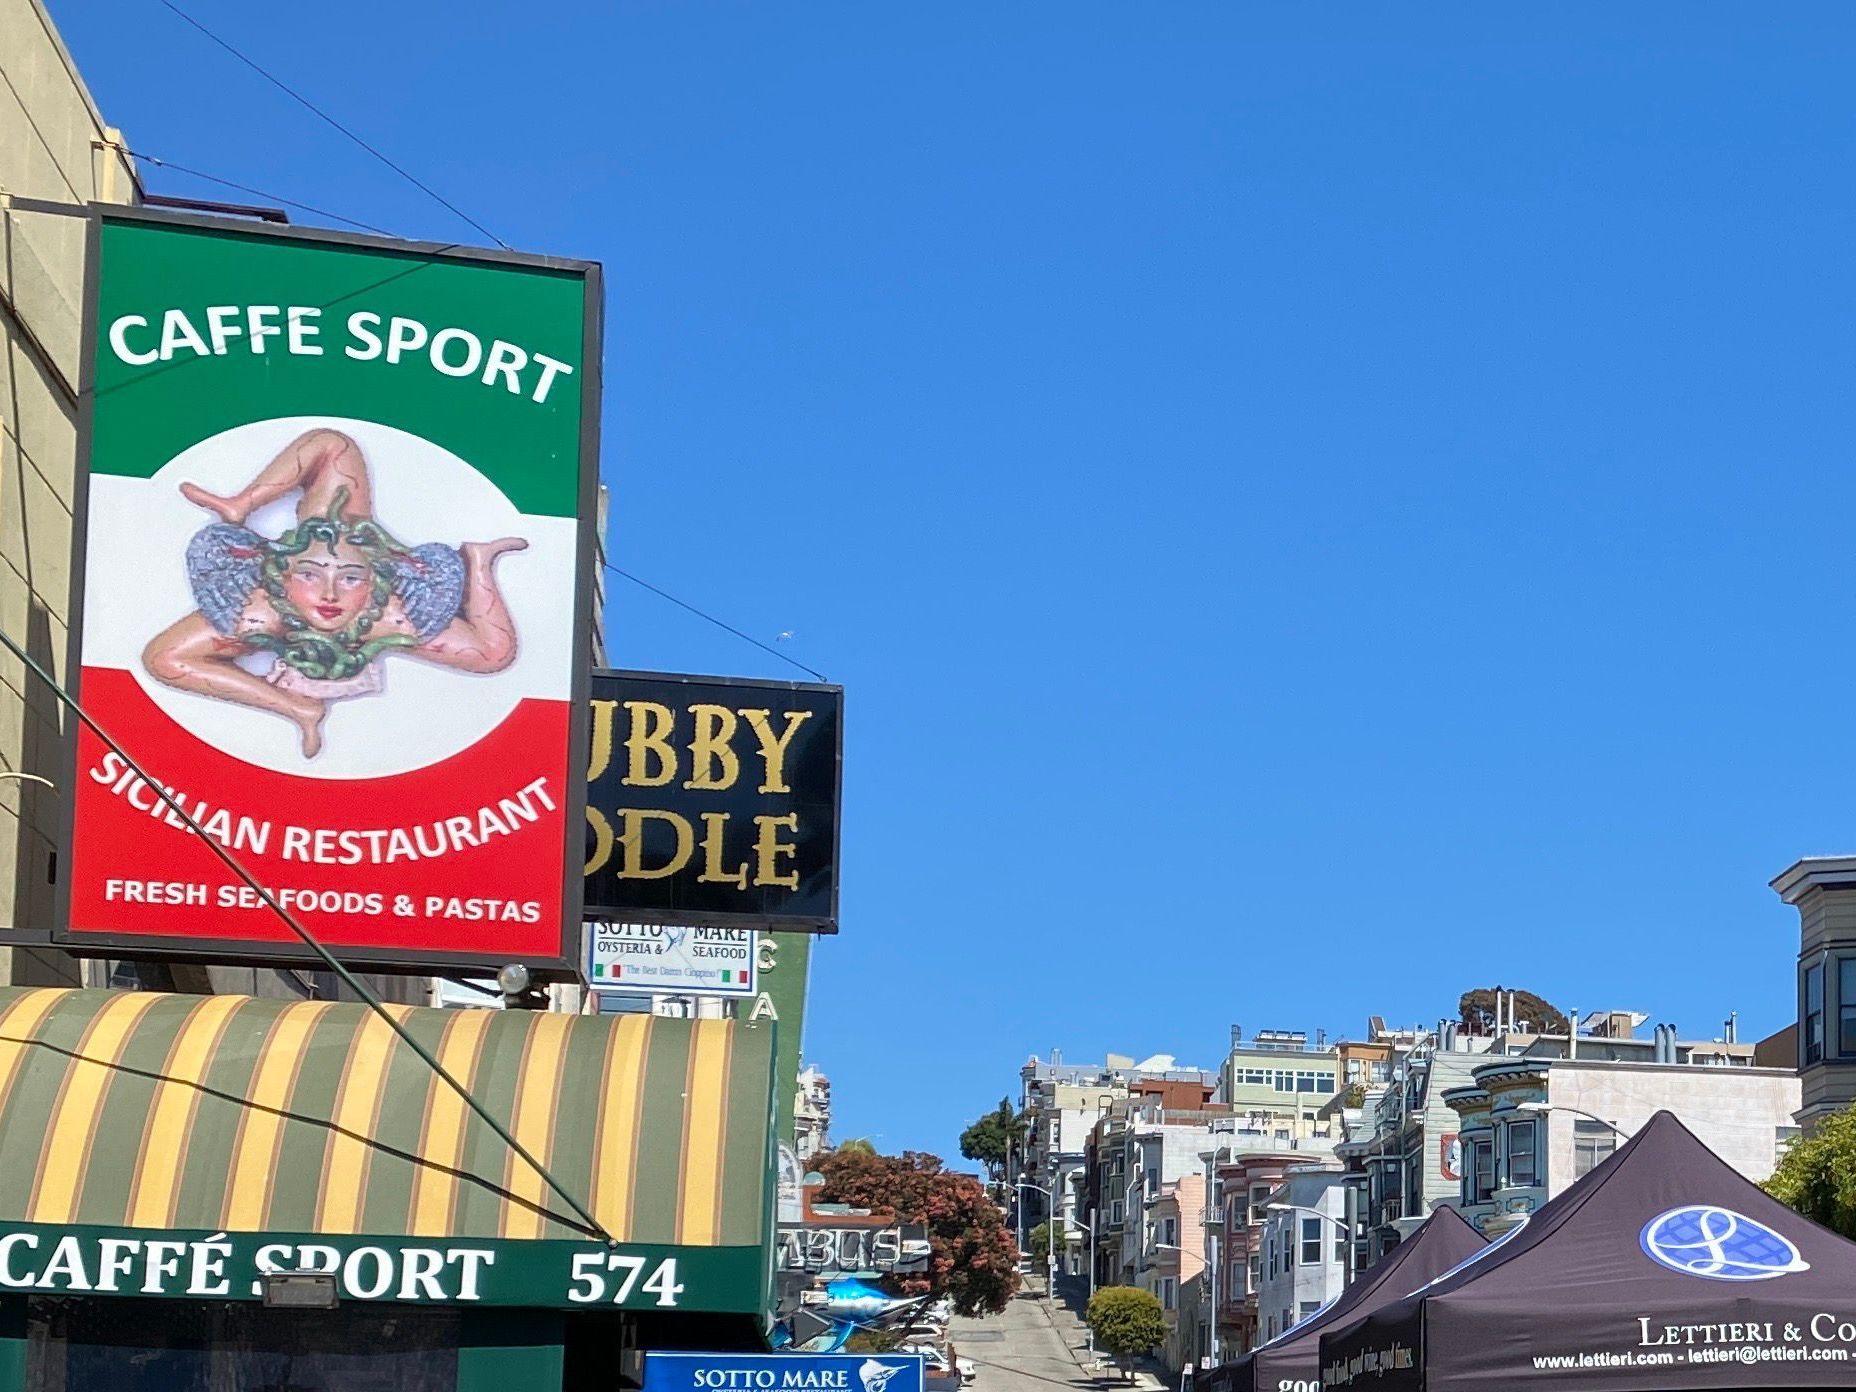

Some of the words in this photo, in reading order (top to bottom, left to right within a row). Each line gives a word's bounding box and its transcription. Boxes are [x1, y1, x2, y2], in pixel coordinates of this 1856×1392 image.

[107, 304, 324, 366] CAFFE
[344, 310, 574, 404] SPORT
[89, 751, 271, 855] SICILIAN
[282, 776, 558, 865] RESTAURANT
[105, 879, 208, 906] FRESH
[217, 884, 384, 915] SEAFOODS
[393, 894, 416, 918] &
[425, 896, 541, 924] PASTAS
[693, 926, 748, 943] MARE
[597, 941, 652, 955] OYSTERIA
[654, 942, 664, 956] &
[692, 945, 747, 960] SEAFOOD
[0, 1233, 230, 1296] CAFFÉ
[254, 1244, 496, 1301] SPORT
[567, 1251, 686, 1307] 574
[1783, 1322, 1802, 1342] &
[1532, 1350, 1674, 1369] www.lettieri.com
[1687, 1346, 1848, 1366] lettieri@lettieri.com
[694, 1368, 775, 1389] SOTTO
[782, 1369, 849, 1389] MARE
